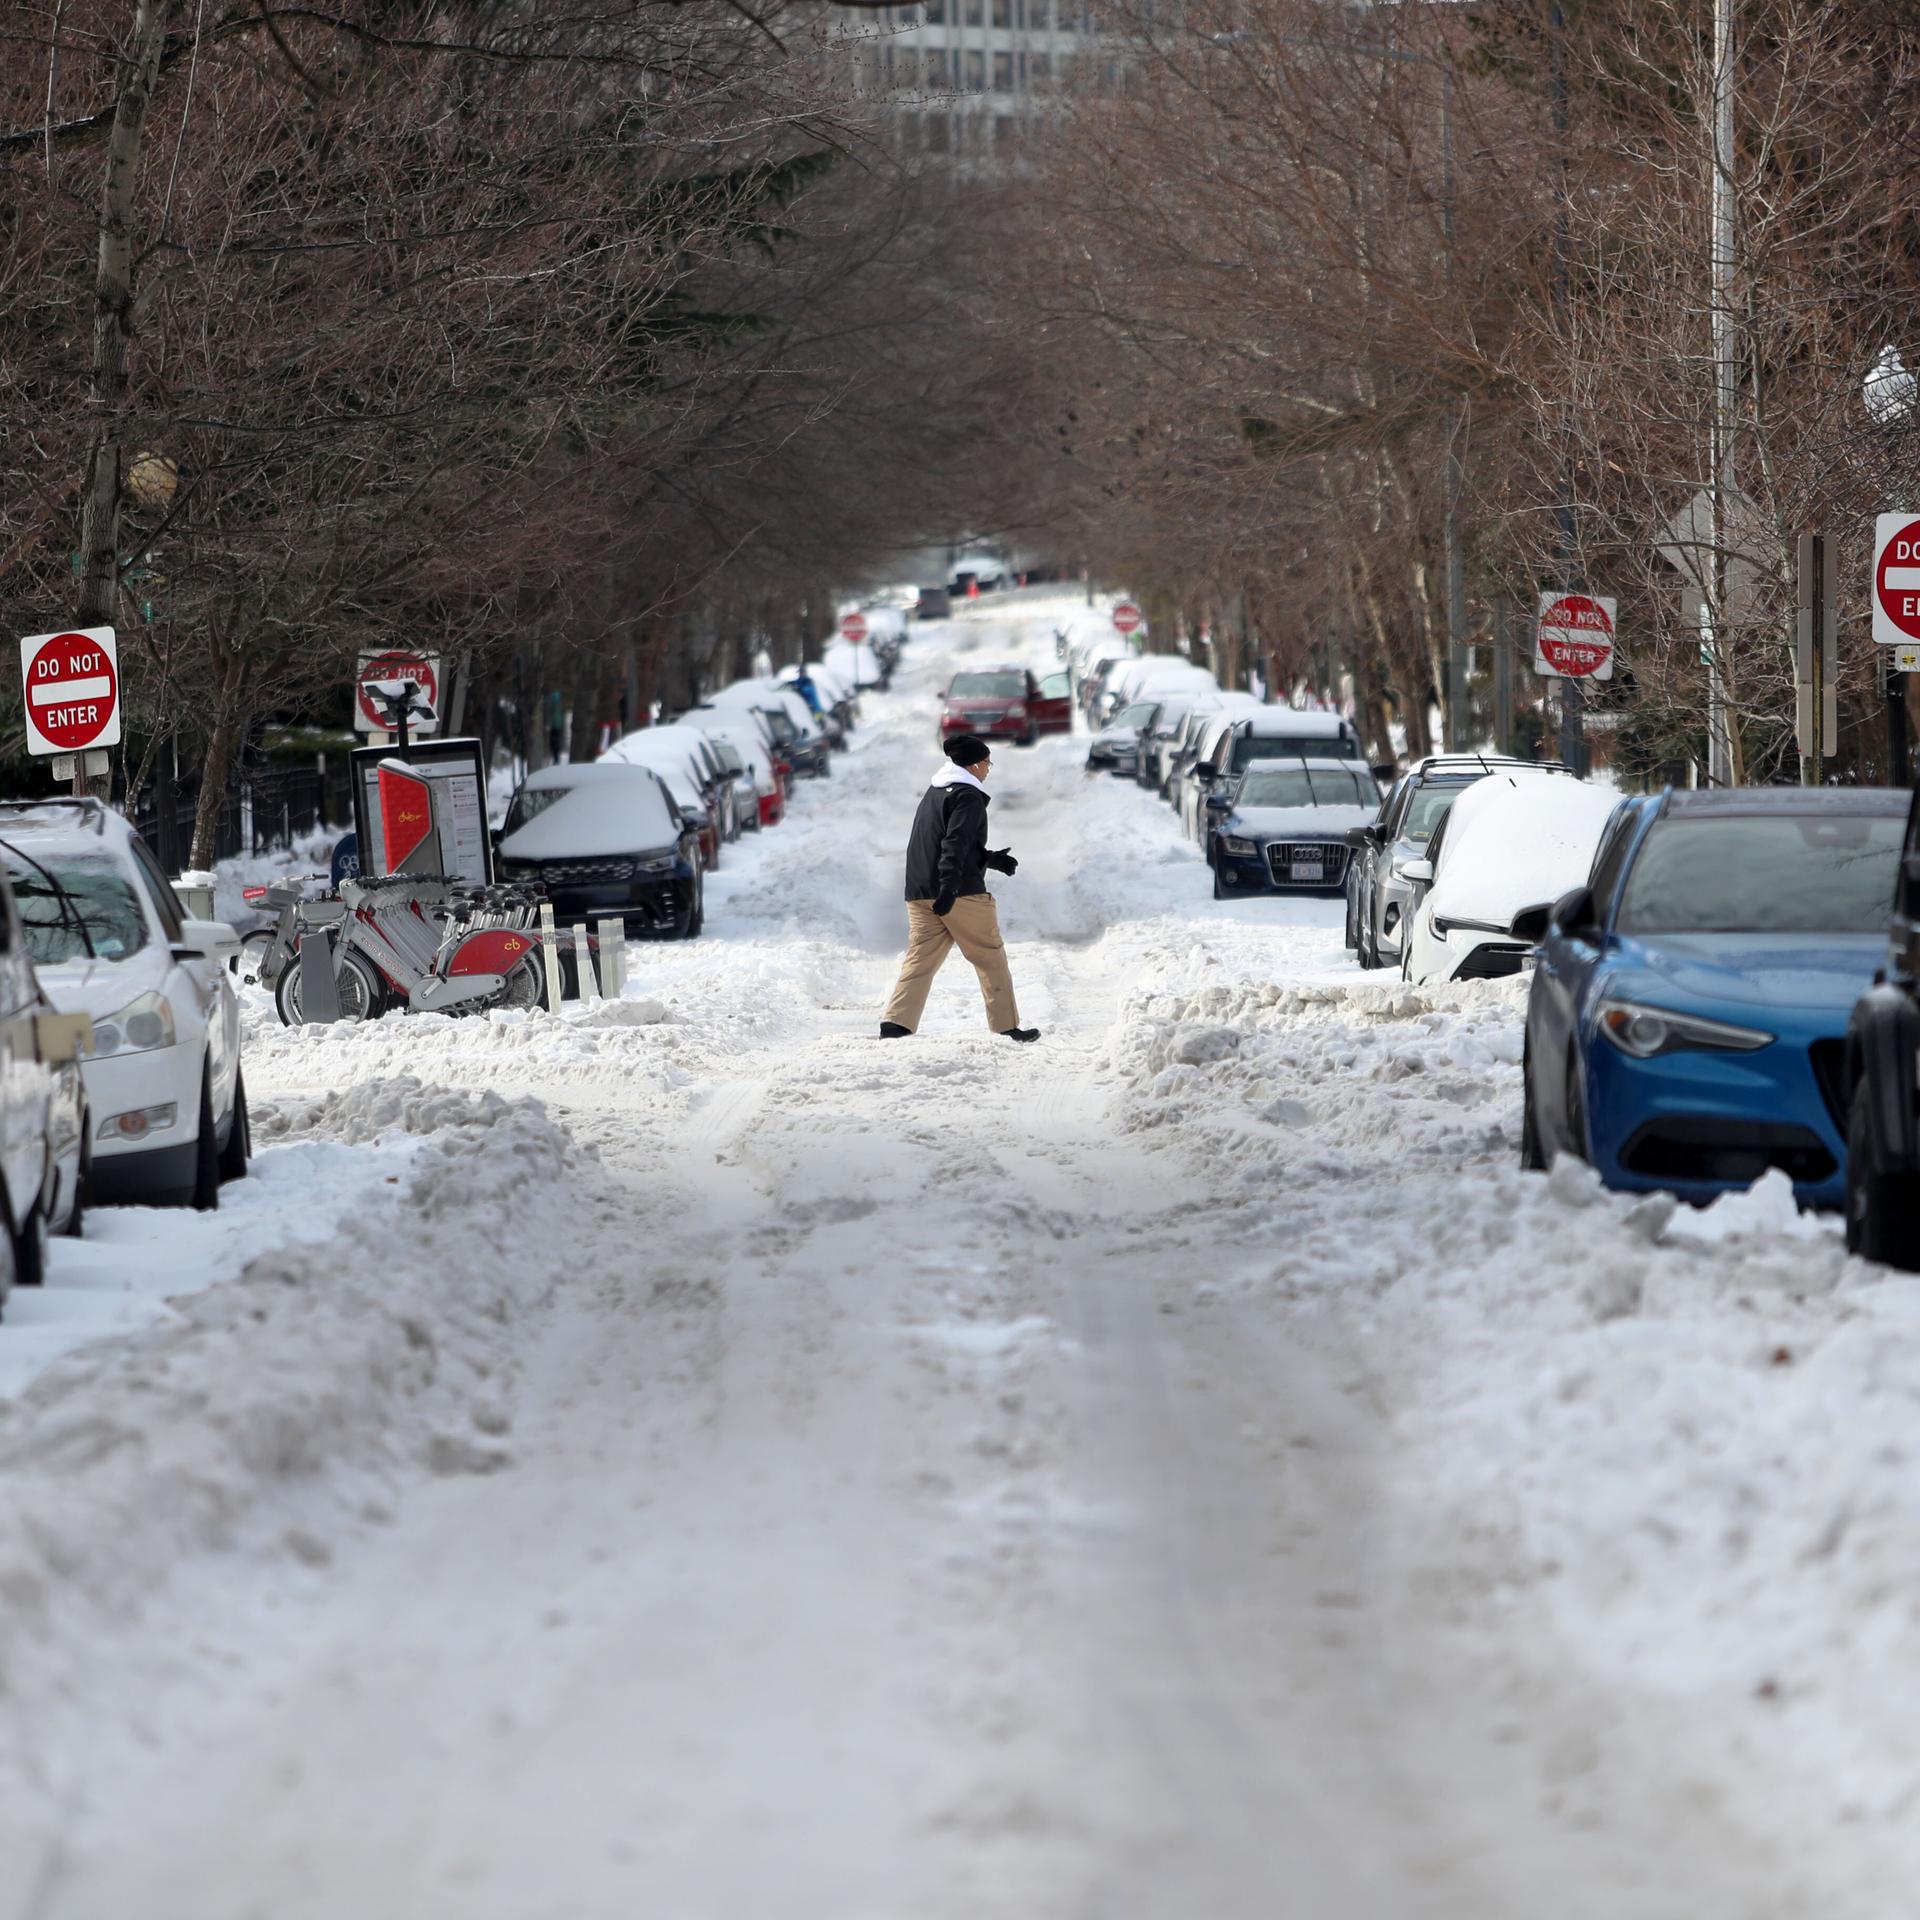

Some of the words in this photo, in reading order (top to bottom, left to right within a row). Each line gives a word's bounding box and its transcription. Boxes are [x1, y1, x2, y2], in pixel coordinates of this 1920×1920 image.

[37, 658, 60, 678] DO
[70, 653, 101, 674] NOT
[47, 705, 98, 729] ENTER
